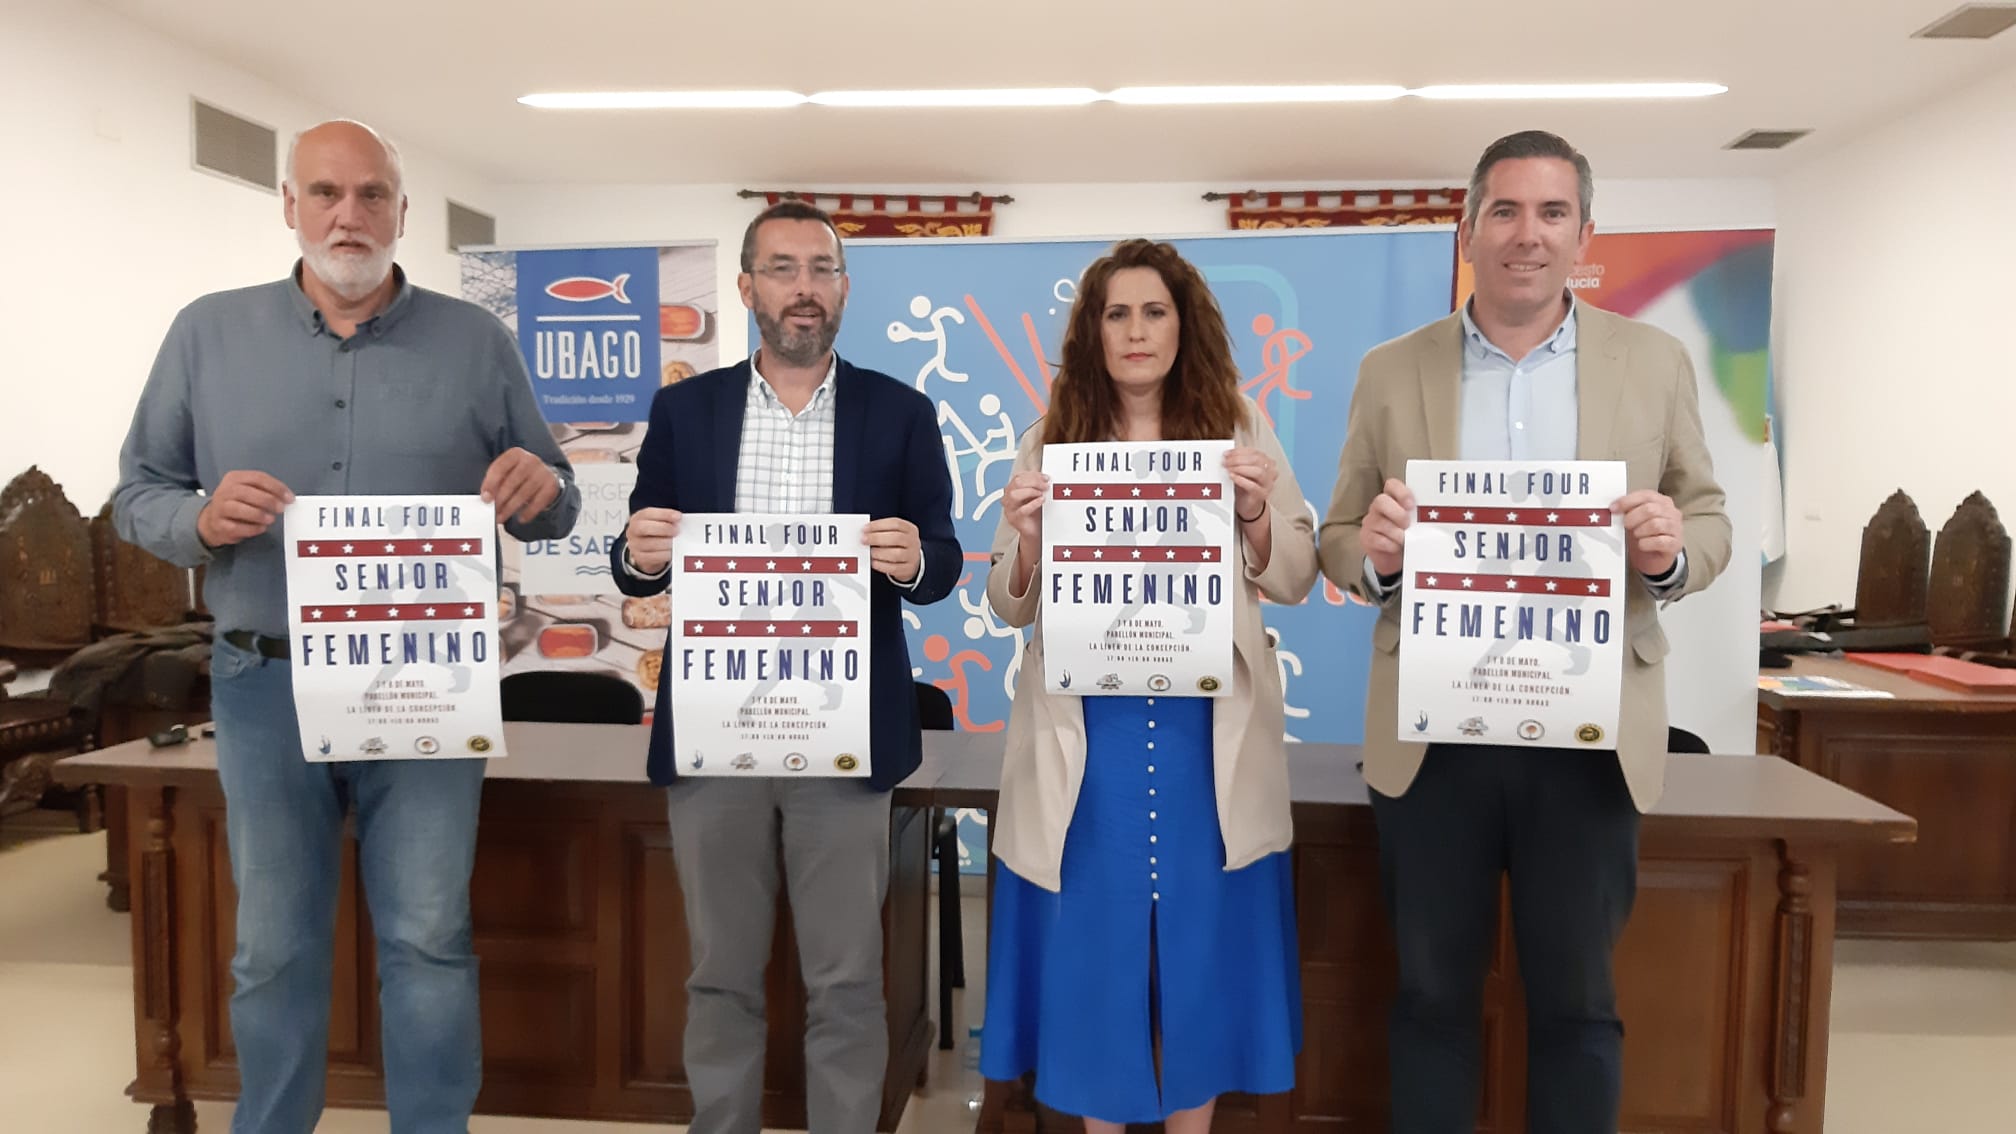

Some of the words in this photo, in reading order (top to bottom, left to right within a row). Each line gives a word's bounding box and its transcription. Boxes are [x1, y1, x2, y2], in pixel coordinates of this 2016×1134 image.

[536, 331, 640, 379] UBAGO
[589, 395, 613, 404] desde
[616, 395, 635, 404] 1929
[1073, 453, 1131, 471] FINAL
[1149, 452, 1201, 471] FOUR
[1440, 473, 1506, 494] FINAL
[1528, 473, 1588, 494] FOUR
[320, 507, 384, 527] FINAL
[404, 506, 459, 526] FOUR
[1086, 506, 1187, 532] SENIOR
[526, 540, 560, 555] DE
[705, 524, 766, 544] FINAL
[784, 525, 837, 545] FOUR
[1455, 531, 1571, 562] SENIOR
[336, 563, 447, 590] SENIOR
[1053, 574, 1221, 605] FEMENINO
[719, 580, 824, 606] SENIOR
[1413, 603, 1609, 644] FEMENINO
[303, 632, 485, 666] FEMENINO
[1507, 657, 1515, 665] DE
[684, 649, 857, 680] FEMENINO
[1493, 684, 1502, 692] DE
[1506, 684, 1515, 692] LA
